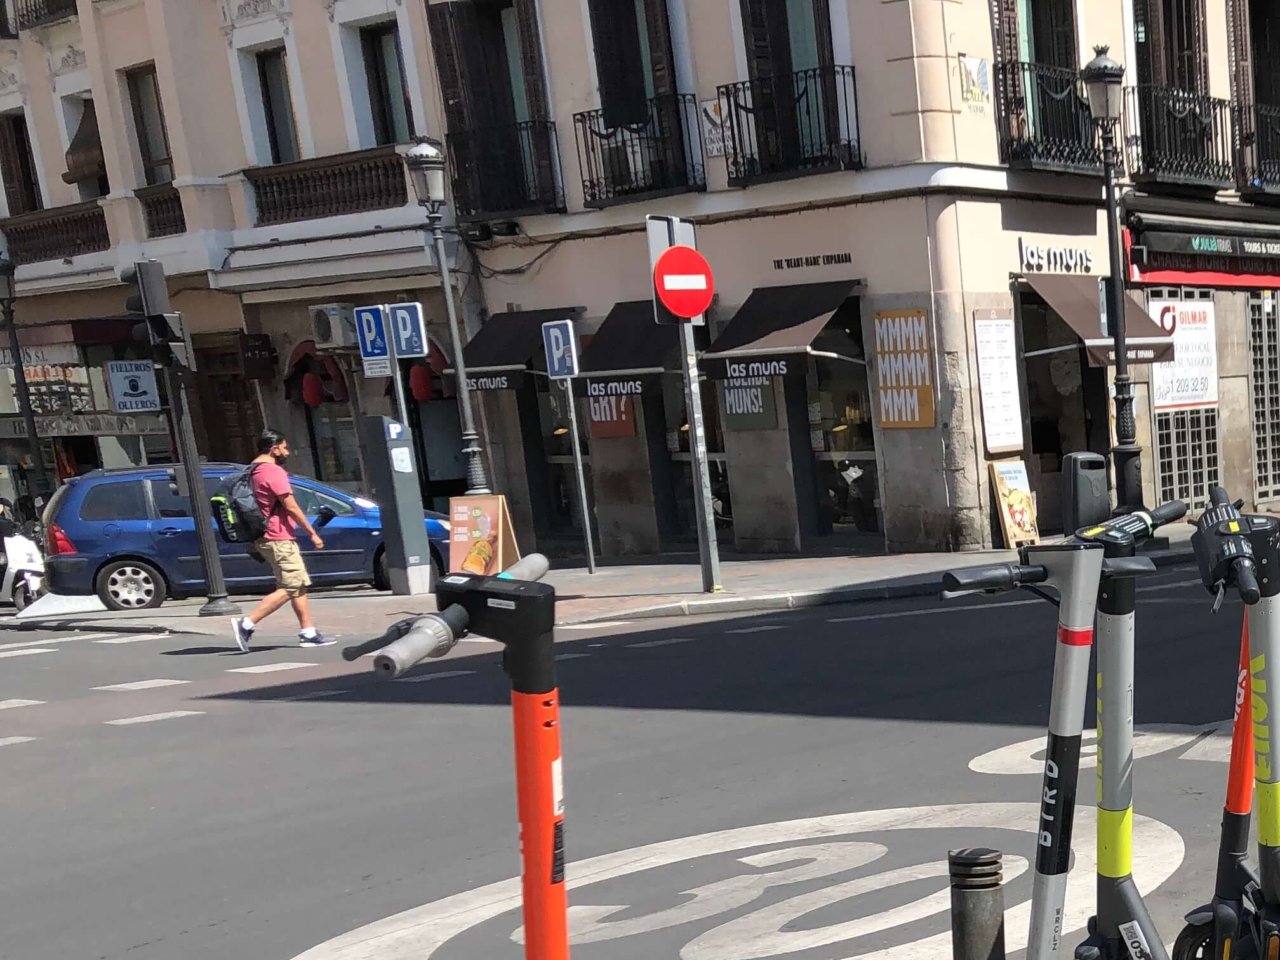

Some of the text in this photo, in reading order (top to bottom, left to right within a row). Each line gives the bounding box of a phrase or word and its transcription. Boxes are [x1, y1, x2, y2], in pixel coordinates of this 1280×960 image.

[396, 309, 412, 350] P
[1180, 311, 1208, 325] GILMAR
[361, 312, 376, 352] P
[874, 316, 927, 351] MMMM
[550, 328, 564, 371] P
[110, 361, 151, 374] FIELTROS
[725, 359, 787, 377] las muns
[877, 352, 930, 387] MMMM
[478, 376, 507, 389] muns
[587, 379, 642, 396] las muns
[117, 400, 158, 411] OLLEROS
[725, 388, 763, 415] MUNS!
[879, 388, 920, 422] MMM
[389, 423, 402, 438] P
[1039, 759, 1059, 848] BIRD
